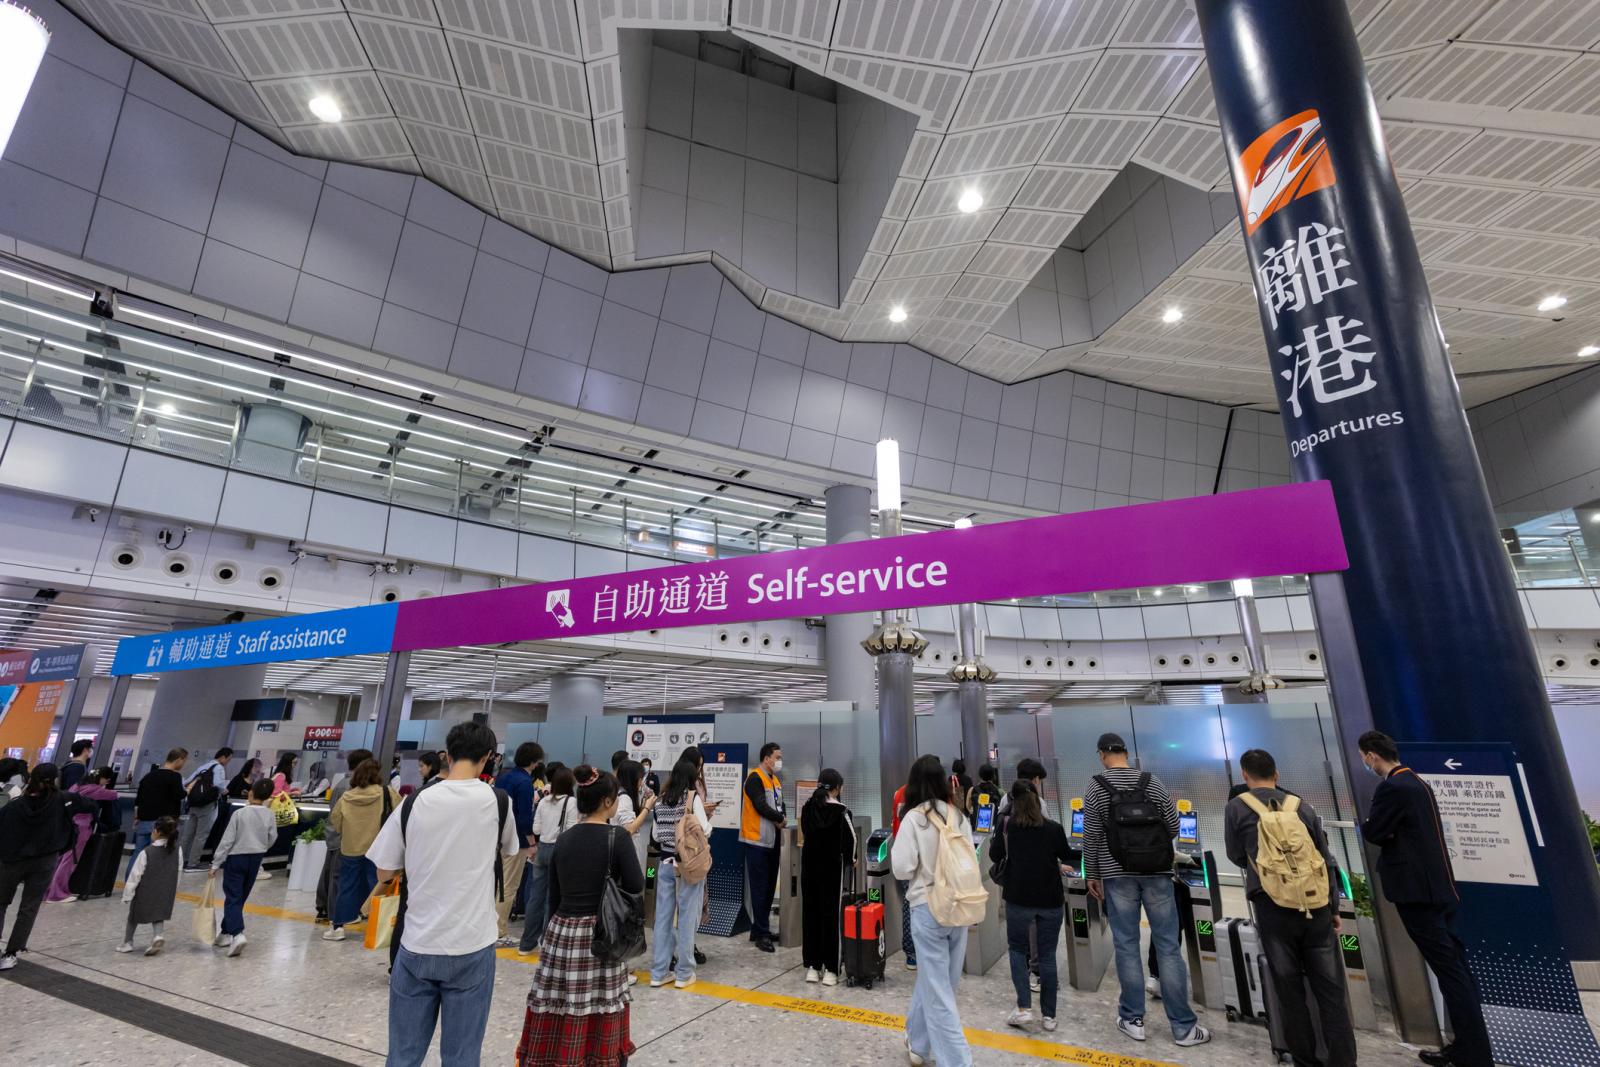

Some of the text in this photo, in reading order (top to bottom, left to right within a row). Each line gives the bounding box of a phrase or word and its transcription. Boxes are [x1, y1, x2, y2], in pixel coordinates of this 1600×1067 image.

[1257, 222, 1377, 418] 離港
[1290, 409, 1405, 458] Departures
[592, 556, 947, 624] 自助通道 Self-service
[167, 627, 347, 664] 輔助通道 Staff assistance
